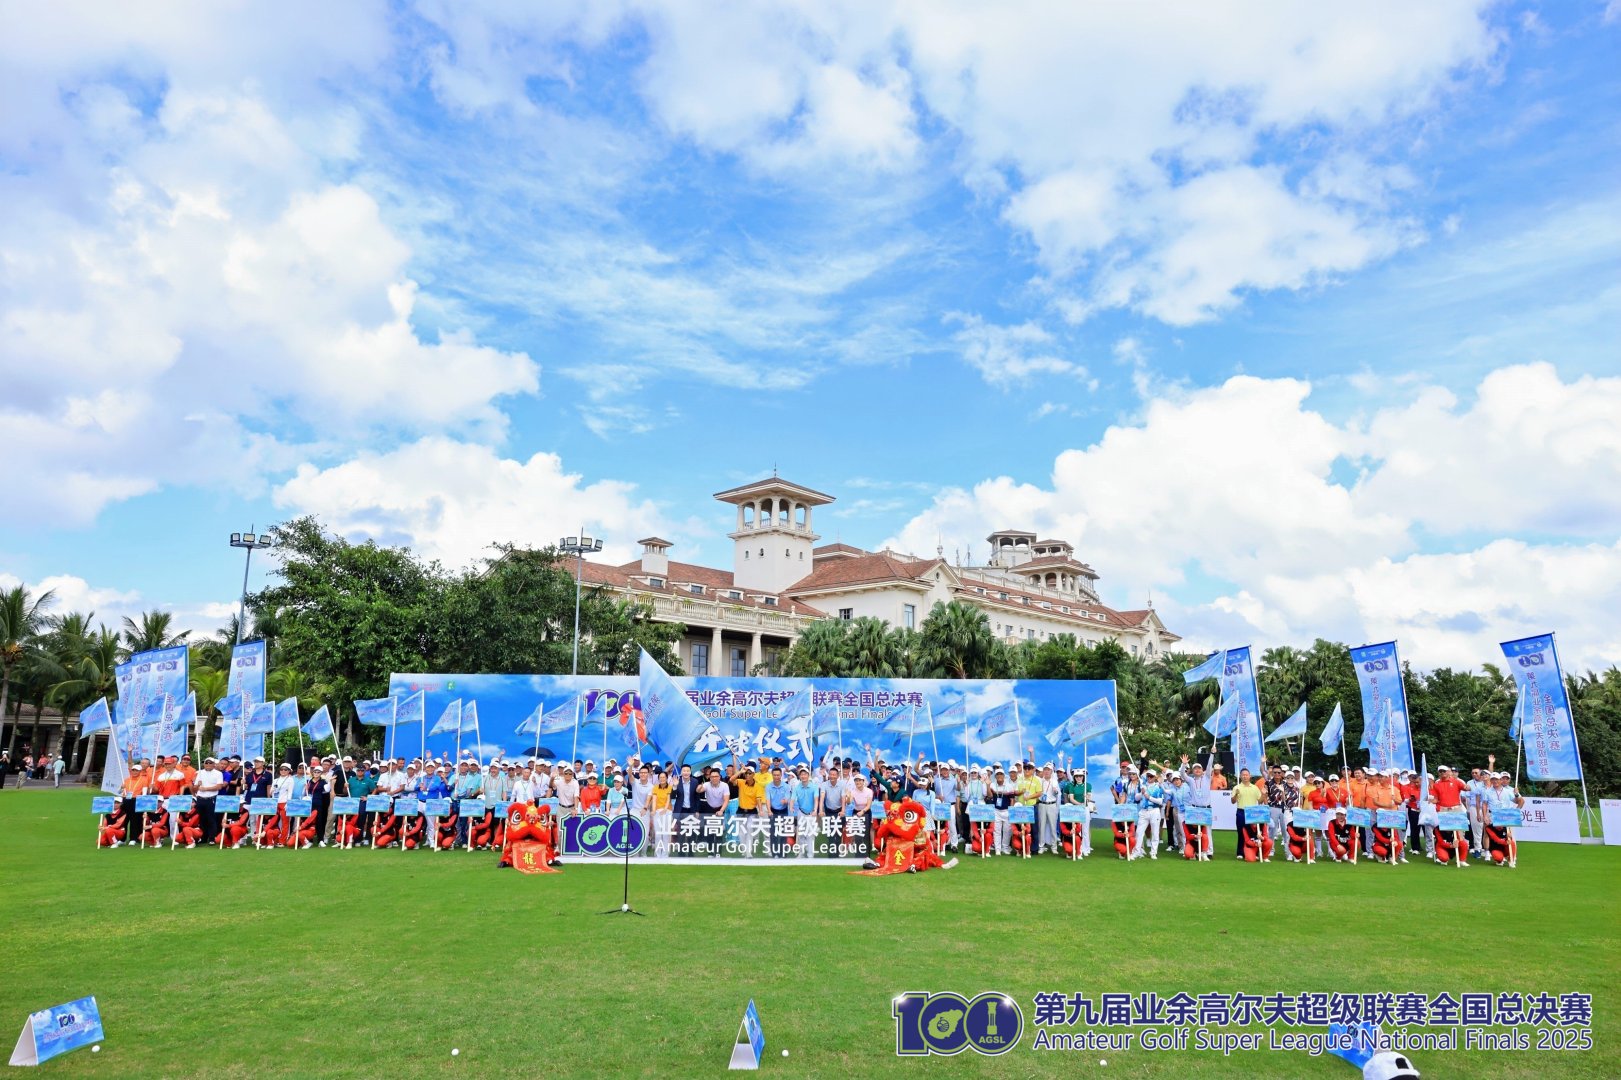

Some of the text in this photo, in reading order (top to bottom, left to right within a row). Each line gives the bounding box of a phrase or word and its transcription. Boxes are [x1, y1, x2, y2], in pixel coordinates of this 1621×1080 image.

[703, 708, 727, 718] Golf
[731, 708, 762, 720] Super
[560, 813, 646, 857] 100
[655, 815, 866, 837] 业余高尔夫超级联赛
[655, 840, 867, 857] Amateur Golf Super League
